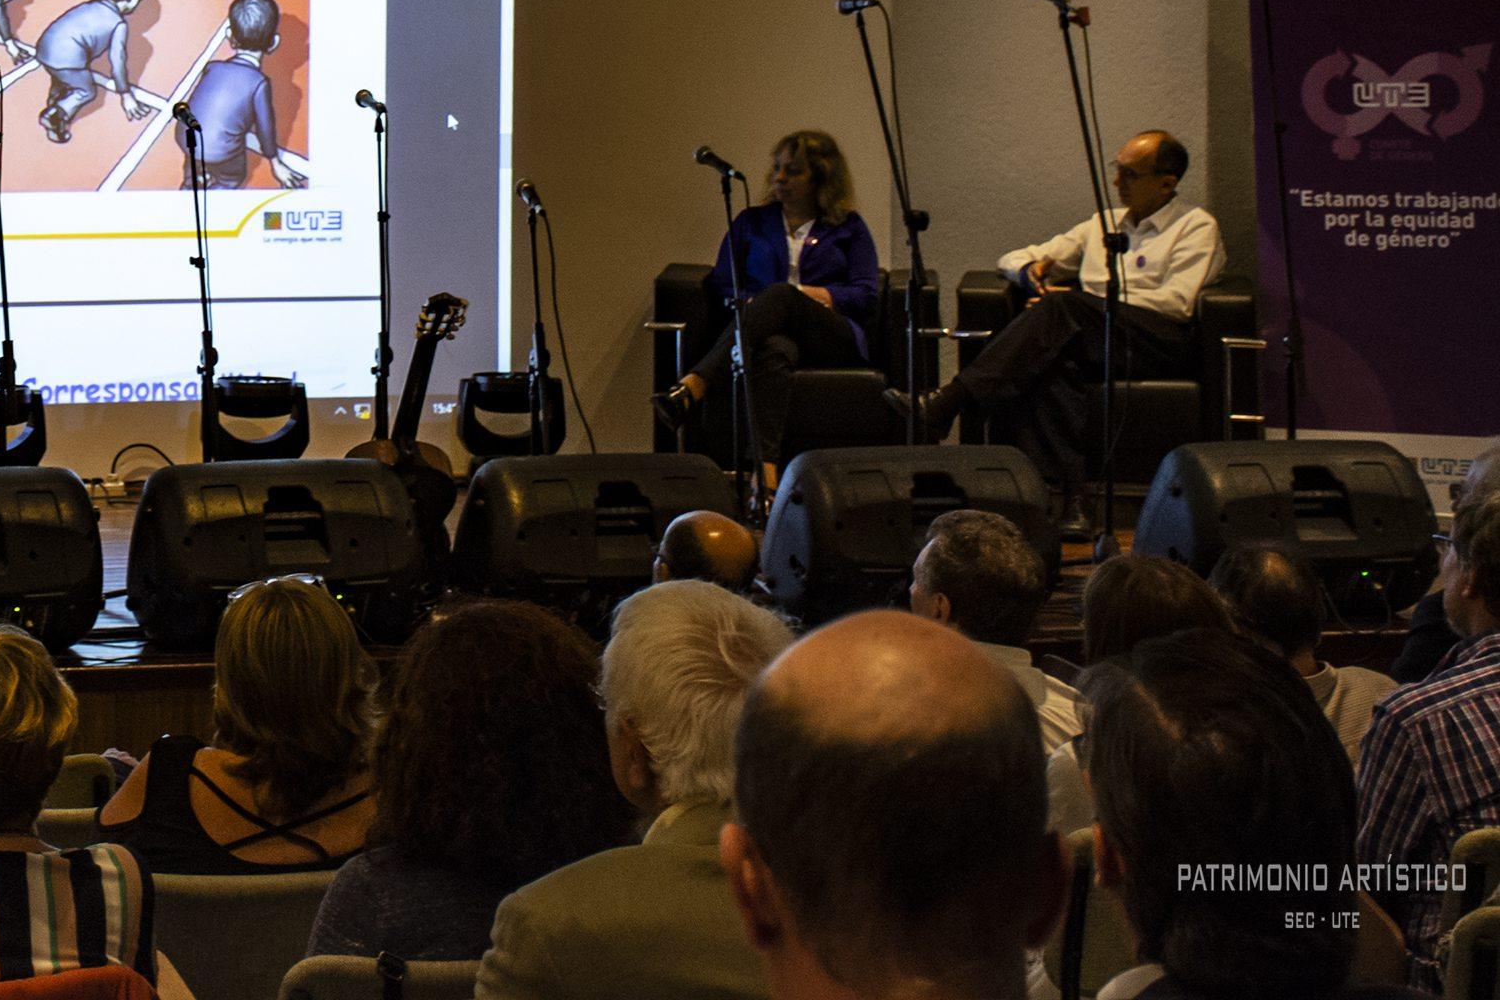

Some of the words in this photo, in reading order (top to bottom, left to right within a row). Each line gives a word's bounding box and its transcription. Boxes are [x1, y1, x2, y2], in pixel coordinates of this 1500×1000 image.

[1353, 82, 1430, 108] UTE
[286, 210, 343, 231] UTE
[1324, 213, 1360, 230] por
[1365, 211, 1385, 228] la
[1391, 212, 1476, 232] equidad
[1344, 229, 1370, 247] de
